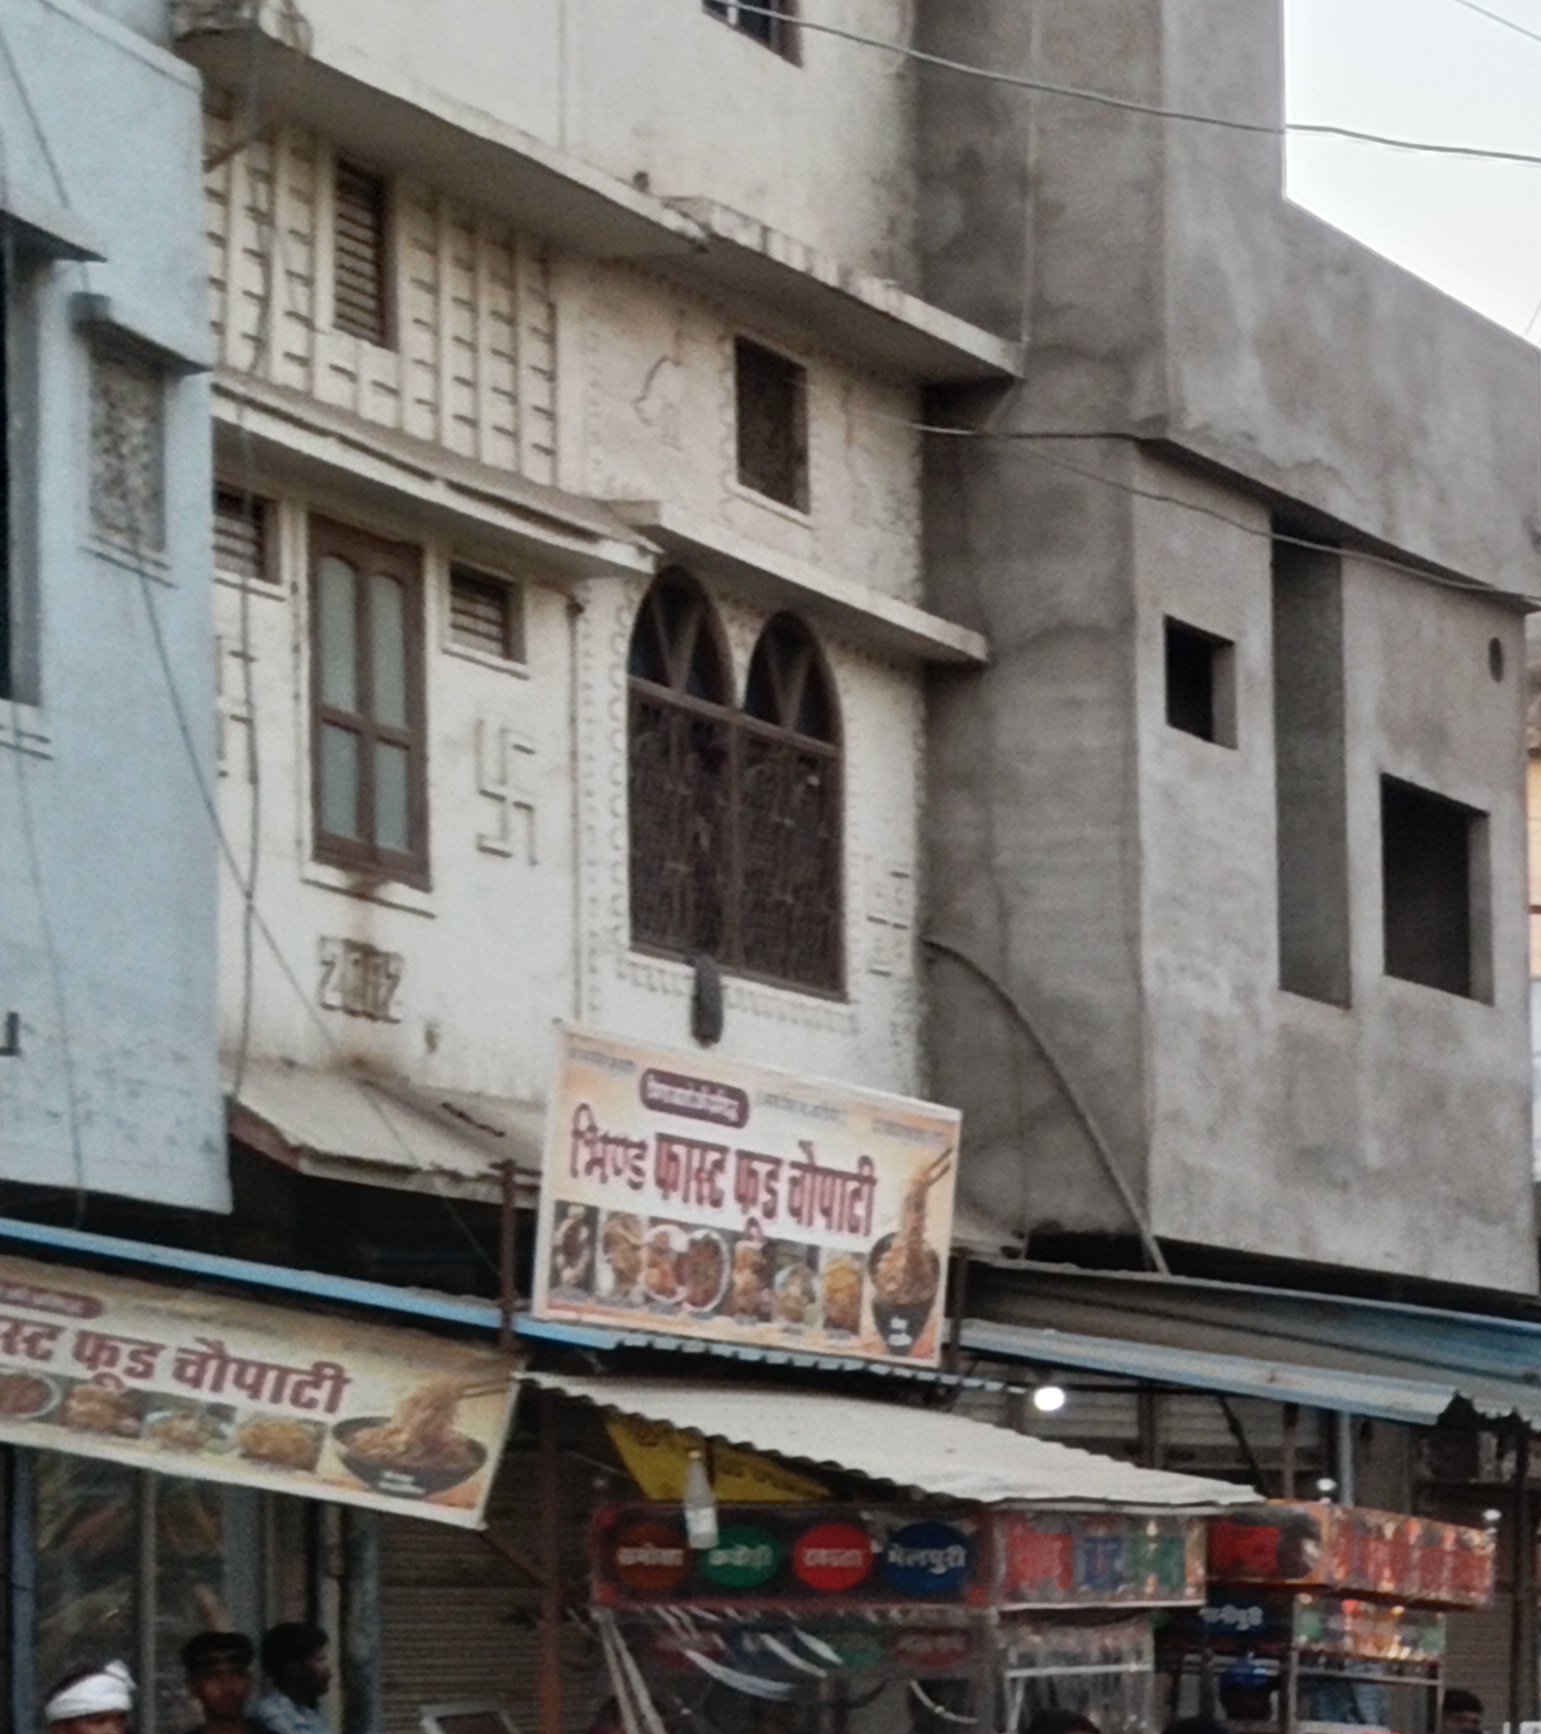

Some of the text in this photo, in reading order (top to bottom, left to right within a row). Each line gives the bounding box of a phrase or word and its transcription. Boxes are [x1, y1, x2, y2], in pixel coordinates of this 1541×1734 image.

[0, 1316, 352, 1414] स्ट फूड चौपाटी
